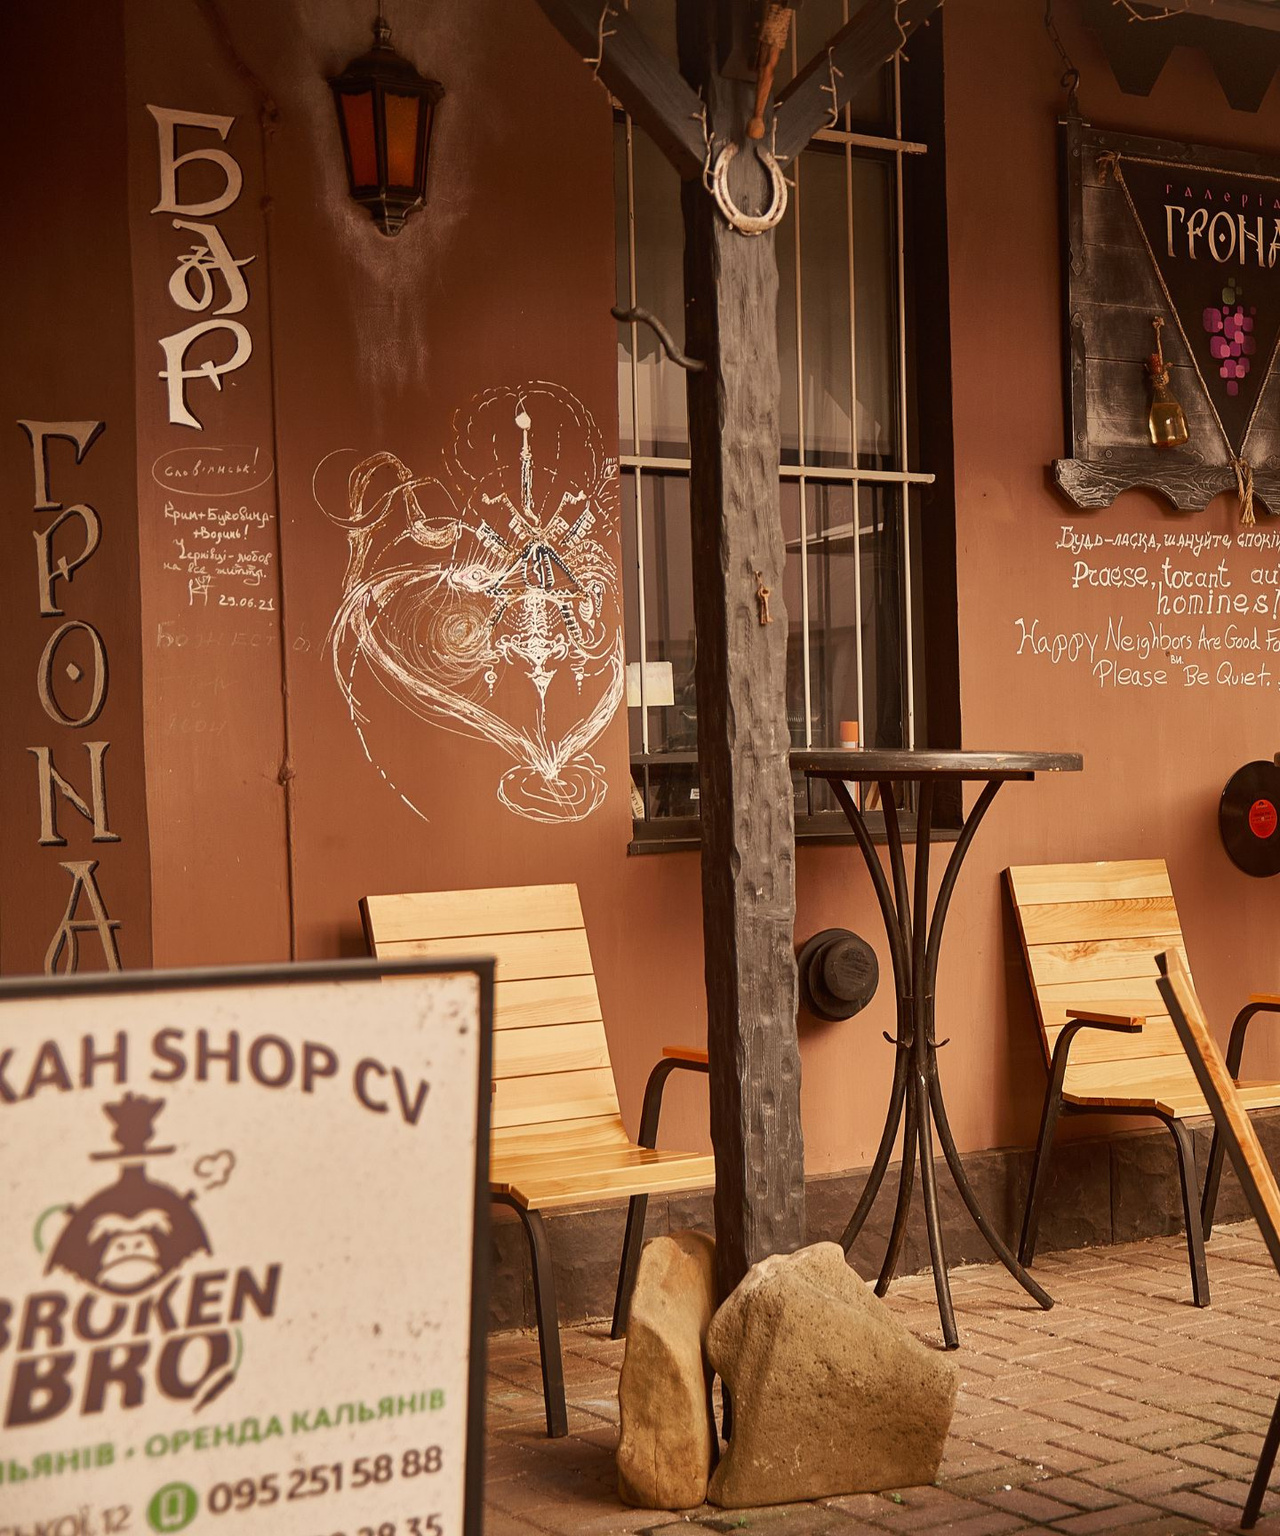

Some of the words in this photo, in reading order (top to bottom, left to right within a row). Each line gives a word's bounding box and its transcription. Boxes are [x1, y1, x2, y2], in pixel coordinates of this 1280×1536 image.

[147, 104, 257, 431] БАР
[218, 594, 275, 611] 29.06.21
[1014, 617, 1098, 664] Happy
[1104, 615, 1193, 660] Neighbors
[1197, 624, 1222, 651] Are
[1223, 624, 1261, 650] Good
[1092, 659, 1168, 688] Please
[1182, 664, 1210, 687] Be
[1215, 660, 1272, 688] Quiet.
[150, 1027, 339, 1093] SHOP
[353, 1057, 430, 1126] CV
[3, 1329, 237, 1428] BRO
[144, 1414, 284, 1458] ОРЕНДА
[291, 1388, 446, 1434] КАЛЬЯНІВ
[207, 1474, 281, 1515] 095
[287, 1462, 344, 1502] 251
[350, 1453, 394, 1489] 58
[402, 1445, 443, 1478] 88
